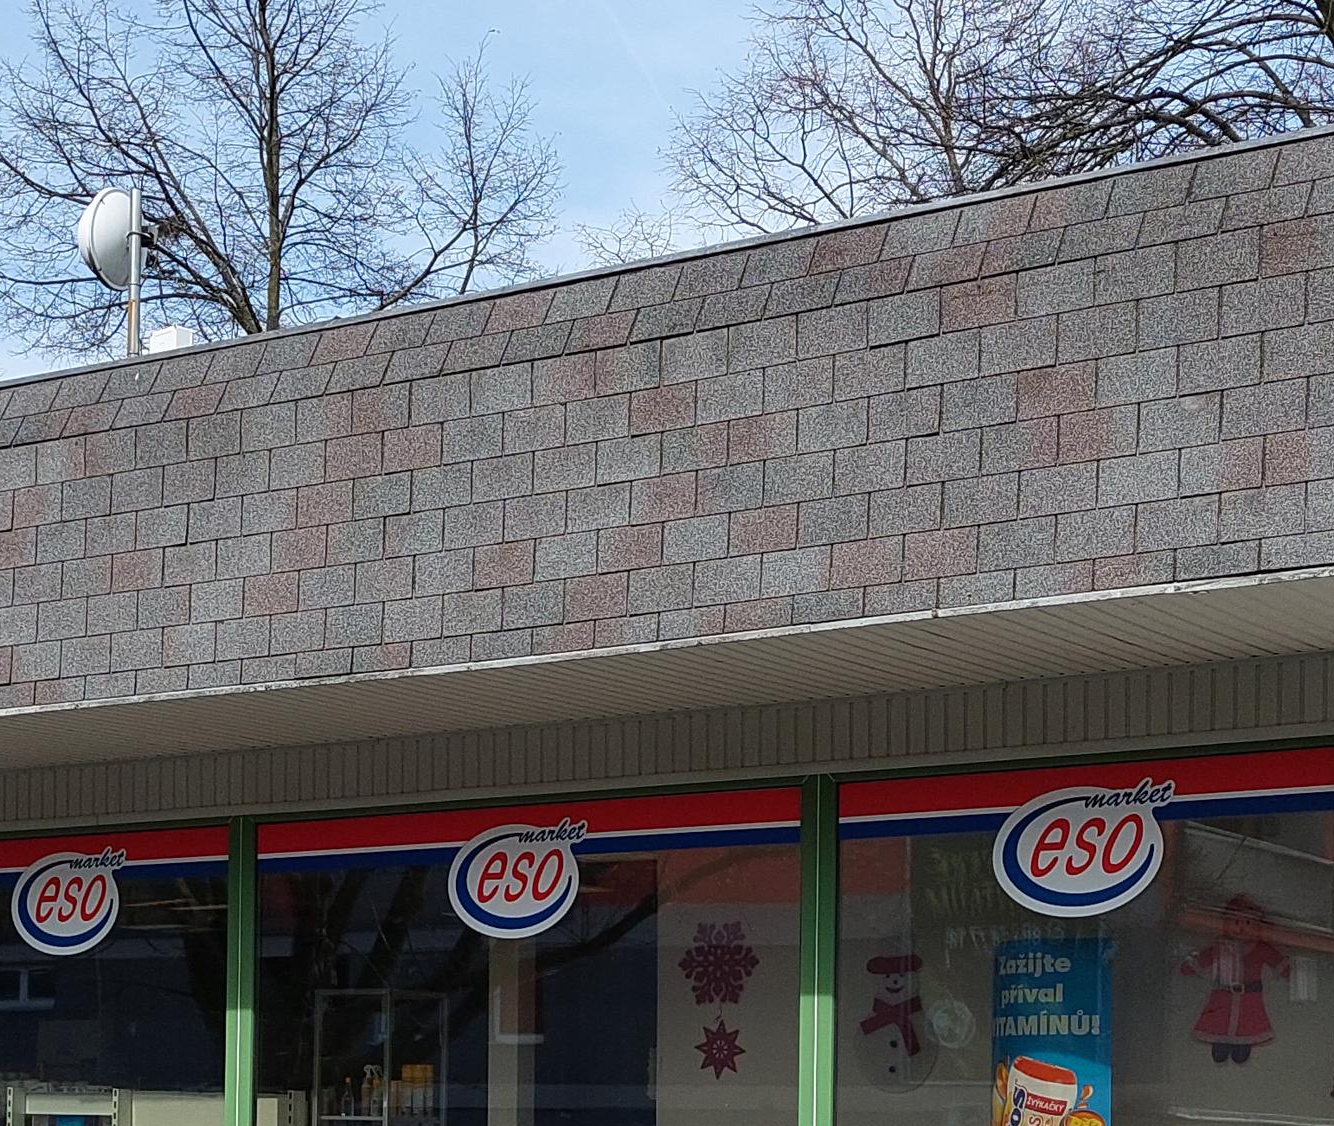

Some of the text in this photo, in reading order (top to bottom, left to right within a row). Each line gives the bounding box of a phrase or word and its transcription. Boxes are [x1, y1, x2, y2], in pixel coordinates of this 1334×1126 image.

[1084, 780, 1172, 808] market
[518, 819, 585, 843] market
[69, 849, 125, 869] market
[1030, 813, 1144, 878] eso
[477, 849, 563, 903] eso
[35, 874, 106, 923] eso
[998, 952, 1071, 977] Zažijte
[1001, 983, 1063, 1008] příval
[993, 1009, 1100, 1037] ITAMÍNŮ!
